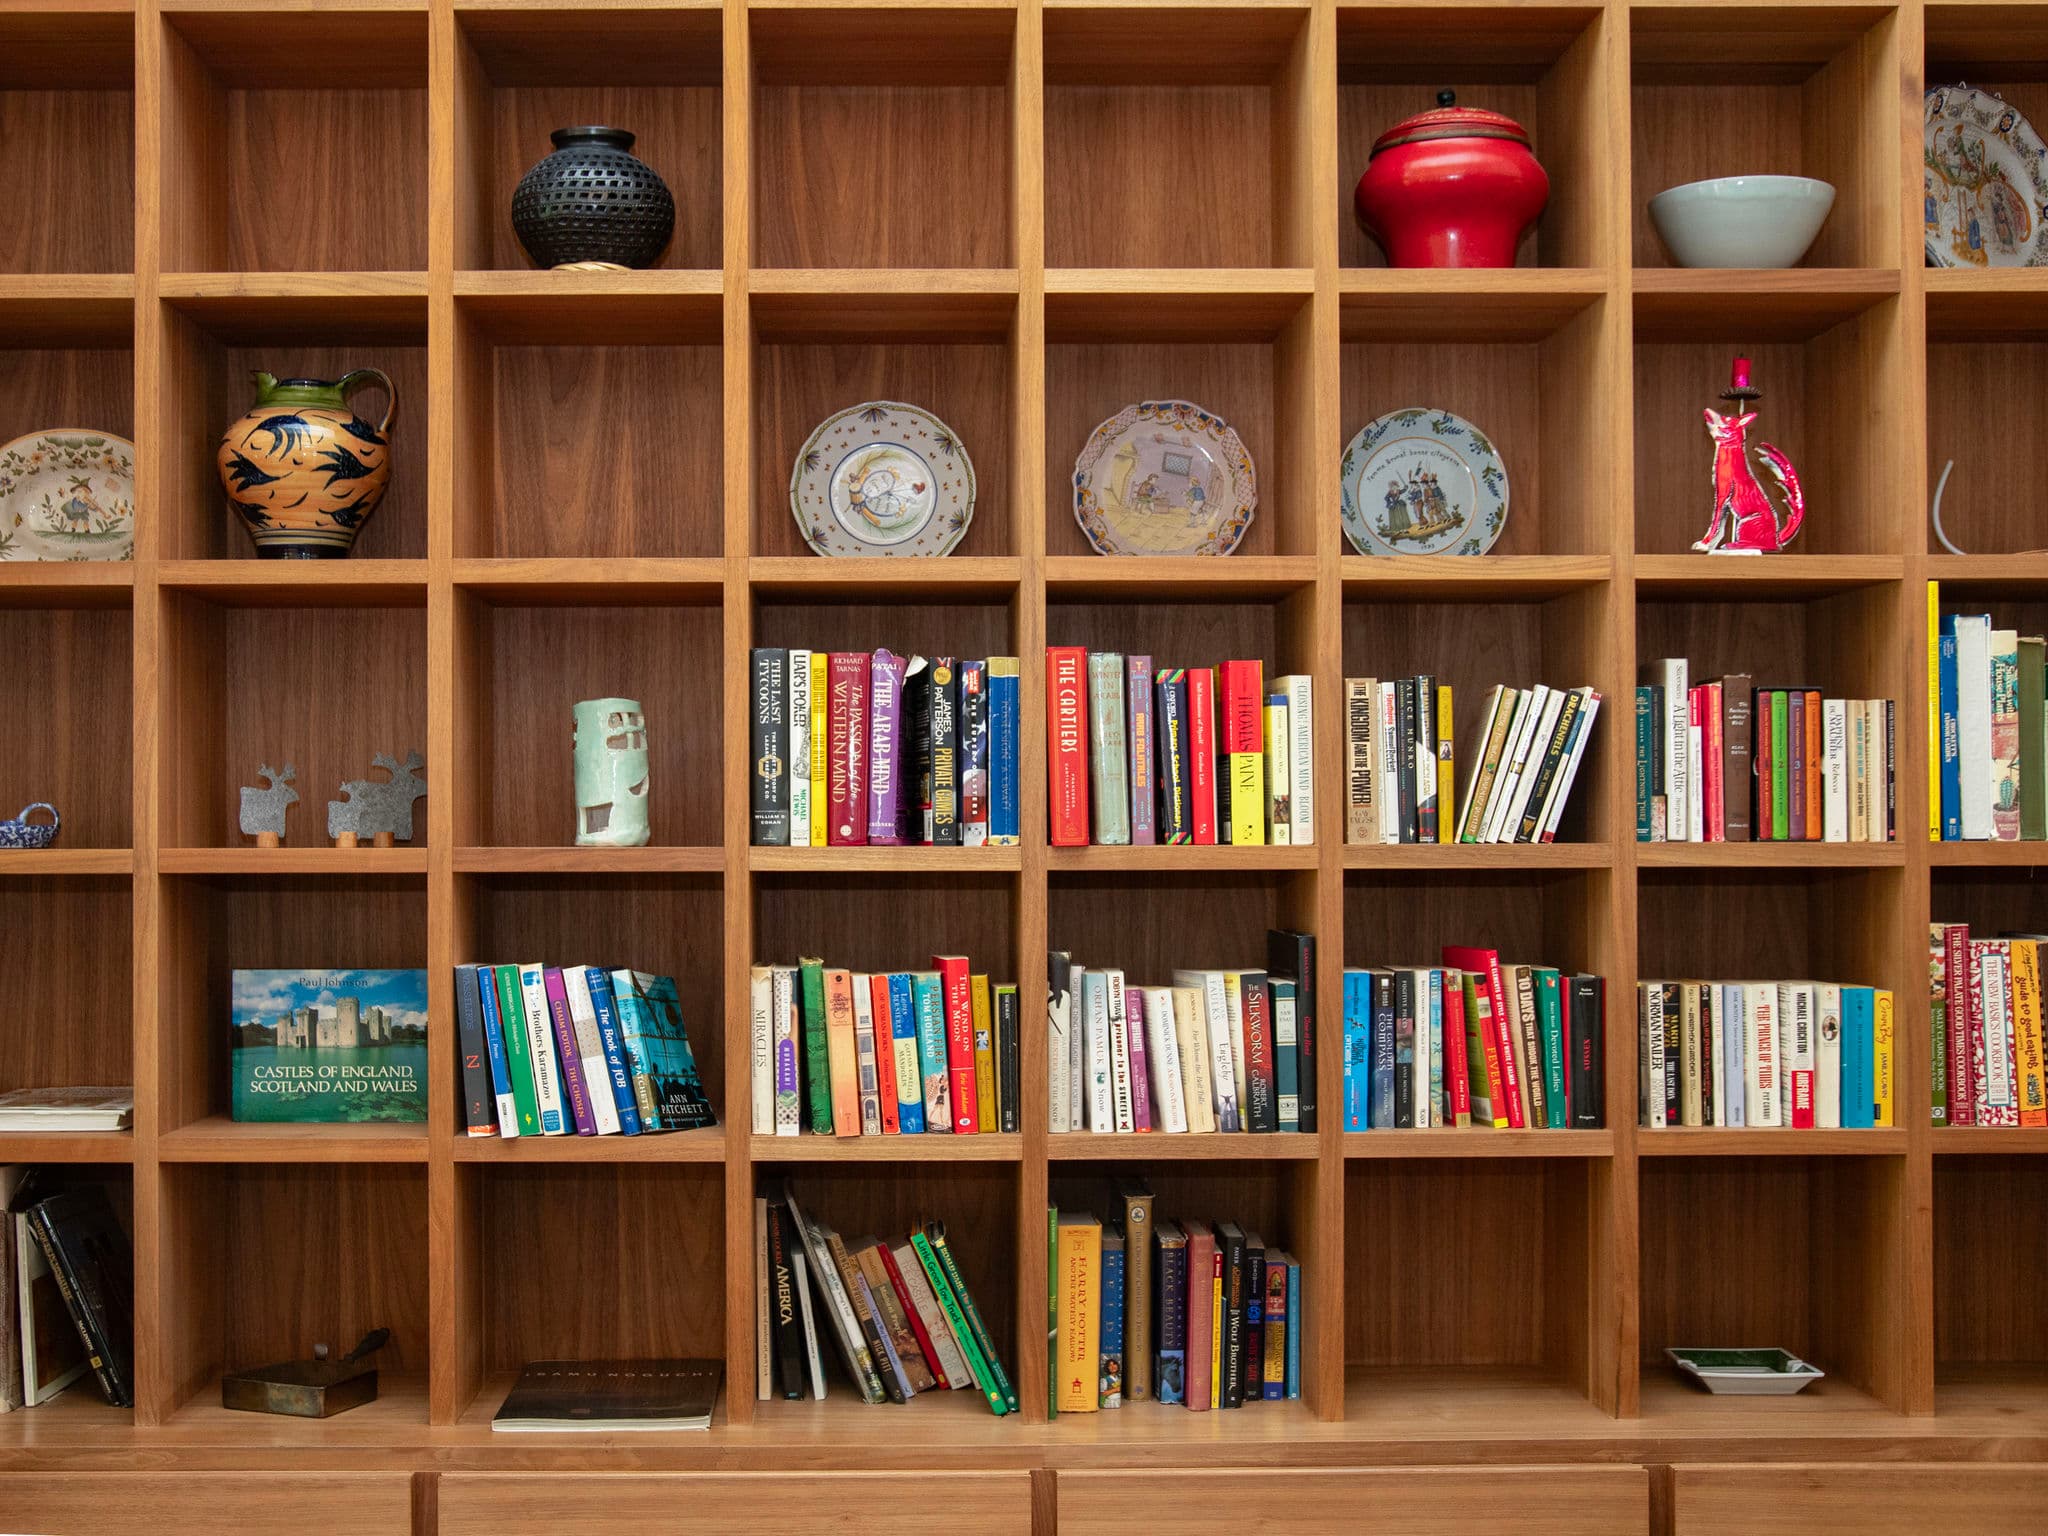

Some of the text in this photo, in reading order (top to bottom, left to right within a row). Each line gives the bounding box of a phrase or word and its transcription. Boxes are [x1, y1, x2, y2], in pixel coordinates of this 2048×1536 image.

[760, 659, 769, 724] TYCOONS
[771, 660, 781, 724] THE LAST
[794, 655, 806, 727] LIAR'S POKER
[935, 687, 943, 744] PATTERSON
[943, 699, 951, 732] JAMES
[1059, 658, 1077, 753] THE CARTIERS
[1996, 663, 2006, 723] House Plants
[2005, 665, 2015, 718] Success with
[833, 680, 846, 802] WESTERN MIND
[850, 685, 862, 798] The PASSION of the
[872, 679, 892, 795] THE ARAB MIND
[1170, 720, 1178, 751] Primary
[1238, 695, 1254, 792] THOMAS PAINE
[1297, 685, 1309, 823] CLOSING AMERICAN MIND BLOOM
[1350, 686, 1371, 804] THE KINGDOM AND THE POWER
[1550, 694, 1579, 756] DRACHENFELS
[1673, 704, 1687, 793] A Light in the Attic
[935, 748, 953, 824] PRIVATE GAMES
[1173, 787, 1181, 828] Dictionary
[299, 978, 368, 987] Paul Johnson
[1491, 969, 1500, 993] ELEMENTS
[2021, 944, 2036, 994] Zingerman's
[554, 1001, 572, 1057] CHAIM POTOK
[755, 1009, 766, 1068] MIRACLES
[922, 993, 934, 1058] TOM HOLLAND
[930, 985, 944, 1064] PERSIAN FIRE
[952, 1009, 961, 1042] MOON
[959, 974, 969, 1052] THE WIND ON
[1248, 993, 1262, 1063] SILKWORM
[1378, 1013, 1386, 1071] COMPASS
[1518, 976, 1542, 1107] 10 DAYS THAT SHOOK THE WORLD
[1649, 991, 1663, 1070] NORMAN MAILER
[1670, 1014, 1678, 1047] MARIO
[1796, 992, 1808, 1053] MICHAEL CRICHTON
[1936, 1008, 1944, 1029] SALLY
[1952, 932, 1967, 1101] THE SILVER PALATE GOOD TIMES COOKBOOK
[1986, 960, 2004, 1081] THE NEW BASICS COOKBOOK
[2015, 976, 2039, 1069] guide to good eating
[254, 1066, 413, 1079] CASTLES OF ENGLAND,
[466, 1055, 480, 1068] Z
[533, 1010, 550, 1100] Brothers Karamazov
[600, 1007, 626, 1088] The Book of JOB
[1217, 1042, 1231, 1081] Engleby
[1487, 1047, 1501, 1086] FEVER
[1551, 1030, 1560, 1092] Devoted Ladies
[1757, 1004, 1773, 1089] THE PRINCE OF TIDES
[1936, 1031, 1944, 1066] CLARKE'S
[250, 1080, 417, 1093] SCOTLAND AND WALES
[569, 1067, 584, 1118] THE CHOSEN
[661, 1103, 703, 1113] PATCHETT
[669, 1094, 688, 1103] ANN
[1098, 1089, 1106, 1113] Snow
[1119, 1086, 1128, 1118] STREETS
[1251, 1069, 1262, 1118] GALBRAITH
[1666, 1061, 1675, 1100] THE LAST DON
[1796, 1072, 1809, 1109] AIRFRAME
[776, 1264, 792, 1326] AMERICA
[917, 1240, 961, 1324] Little Green Tow Truck
[1077, 1256, 1087, 1361] HARRY POTTER
[1164, 1252, 1174, 1346] BLACK BEAUTY
[1229, 1316, 1240, 1391] WOLF BROTHER
